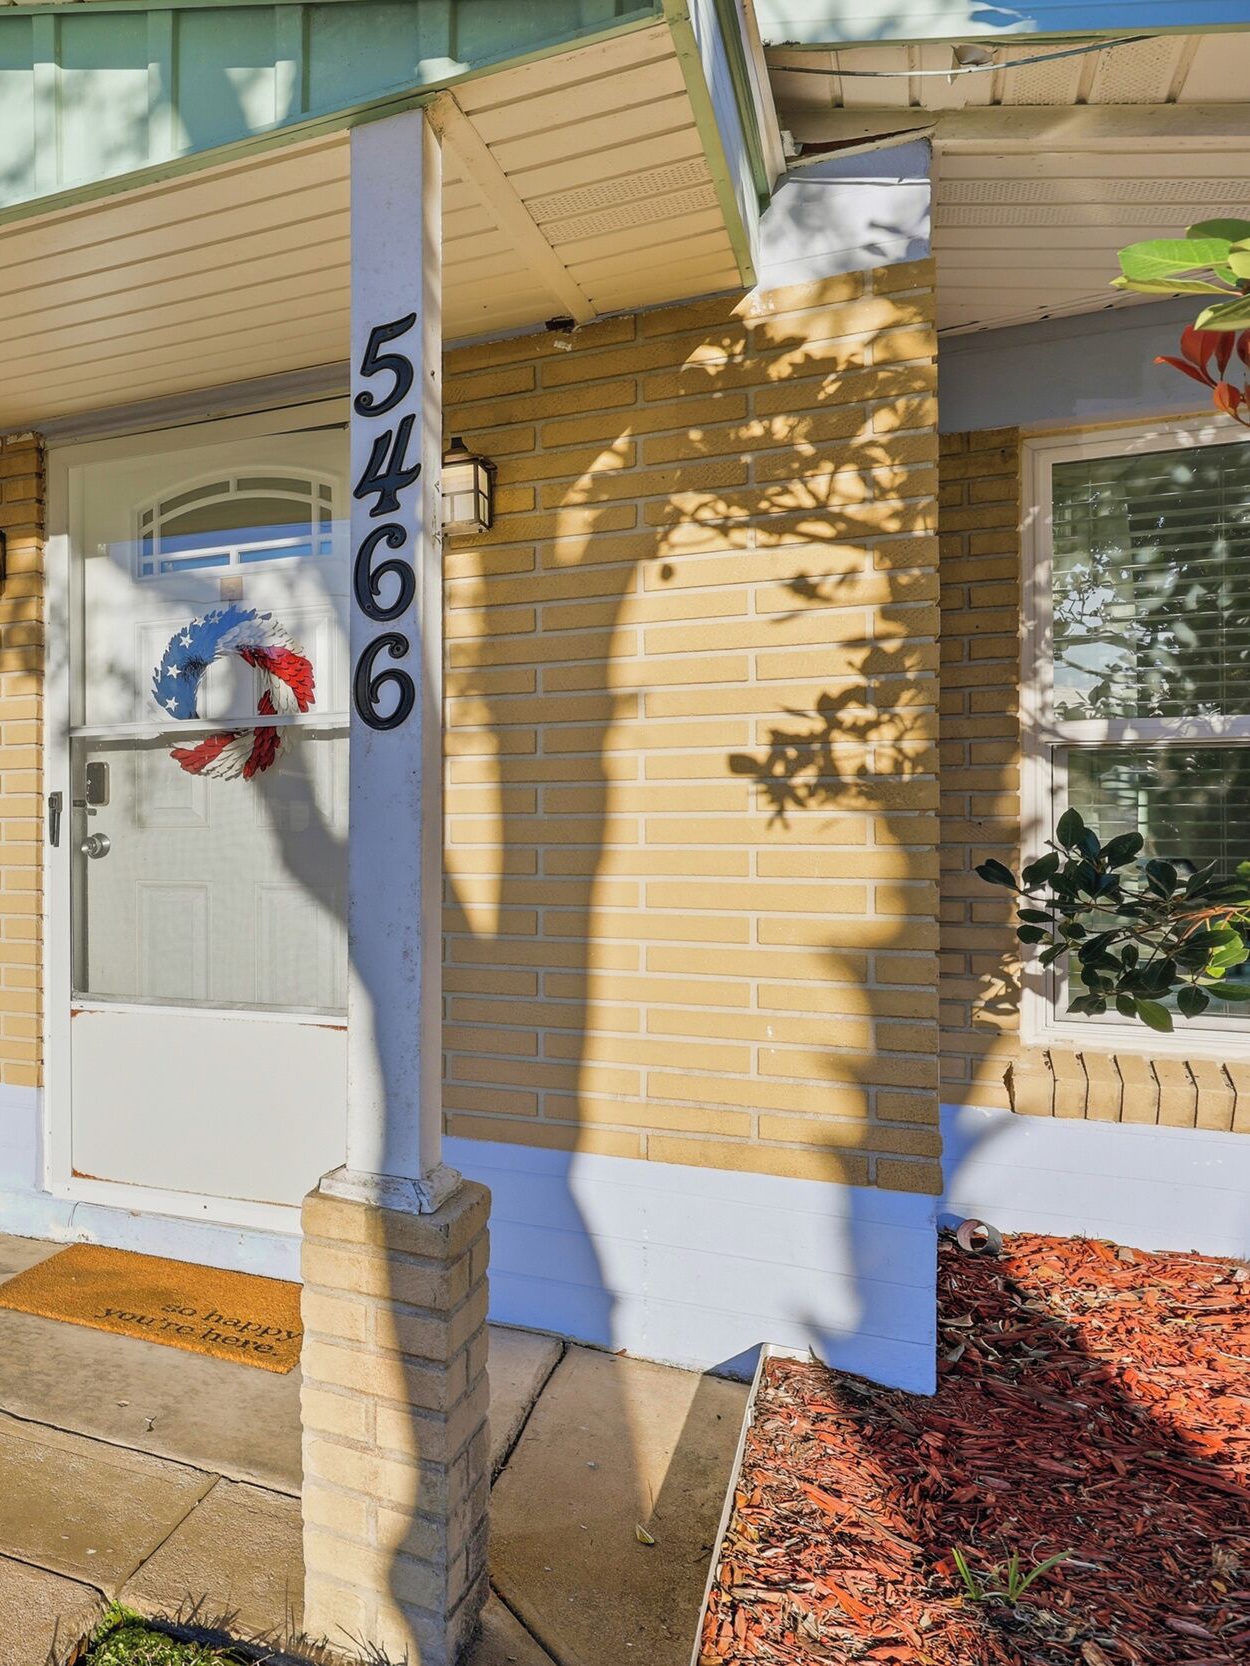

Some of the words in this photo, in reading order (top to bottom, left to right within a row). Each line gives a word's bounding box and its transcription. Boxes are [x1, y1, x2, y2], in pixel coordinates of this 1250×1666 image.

[353, 312, 422, 731] 5466
[94, 1307, 195, 1335] you're
[200, 1327, 278, 1356] here.
[161, 1302, 198, 1317] so
[201, 1310, 303, 1341] happy
